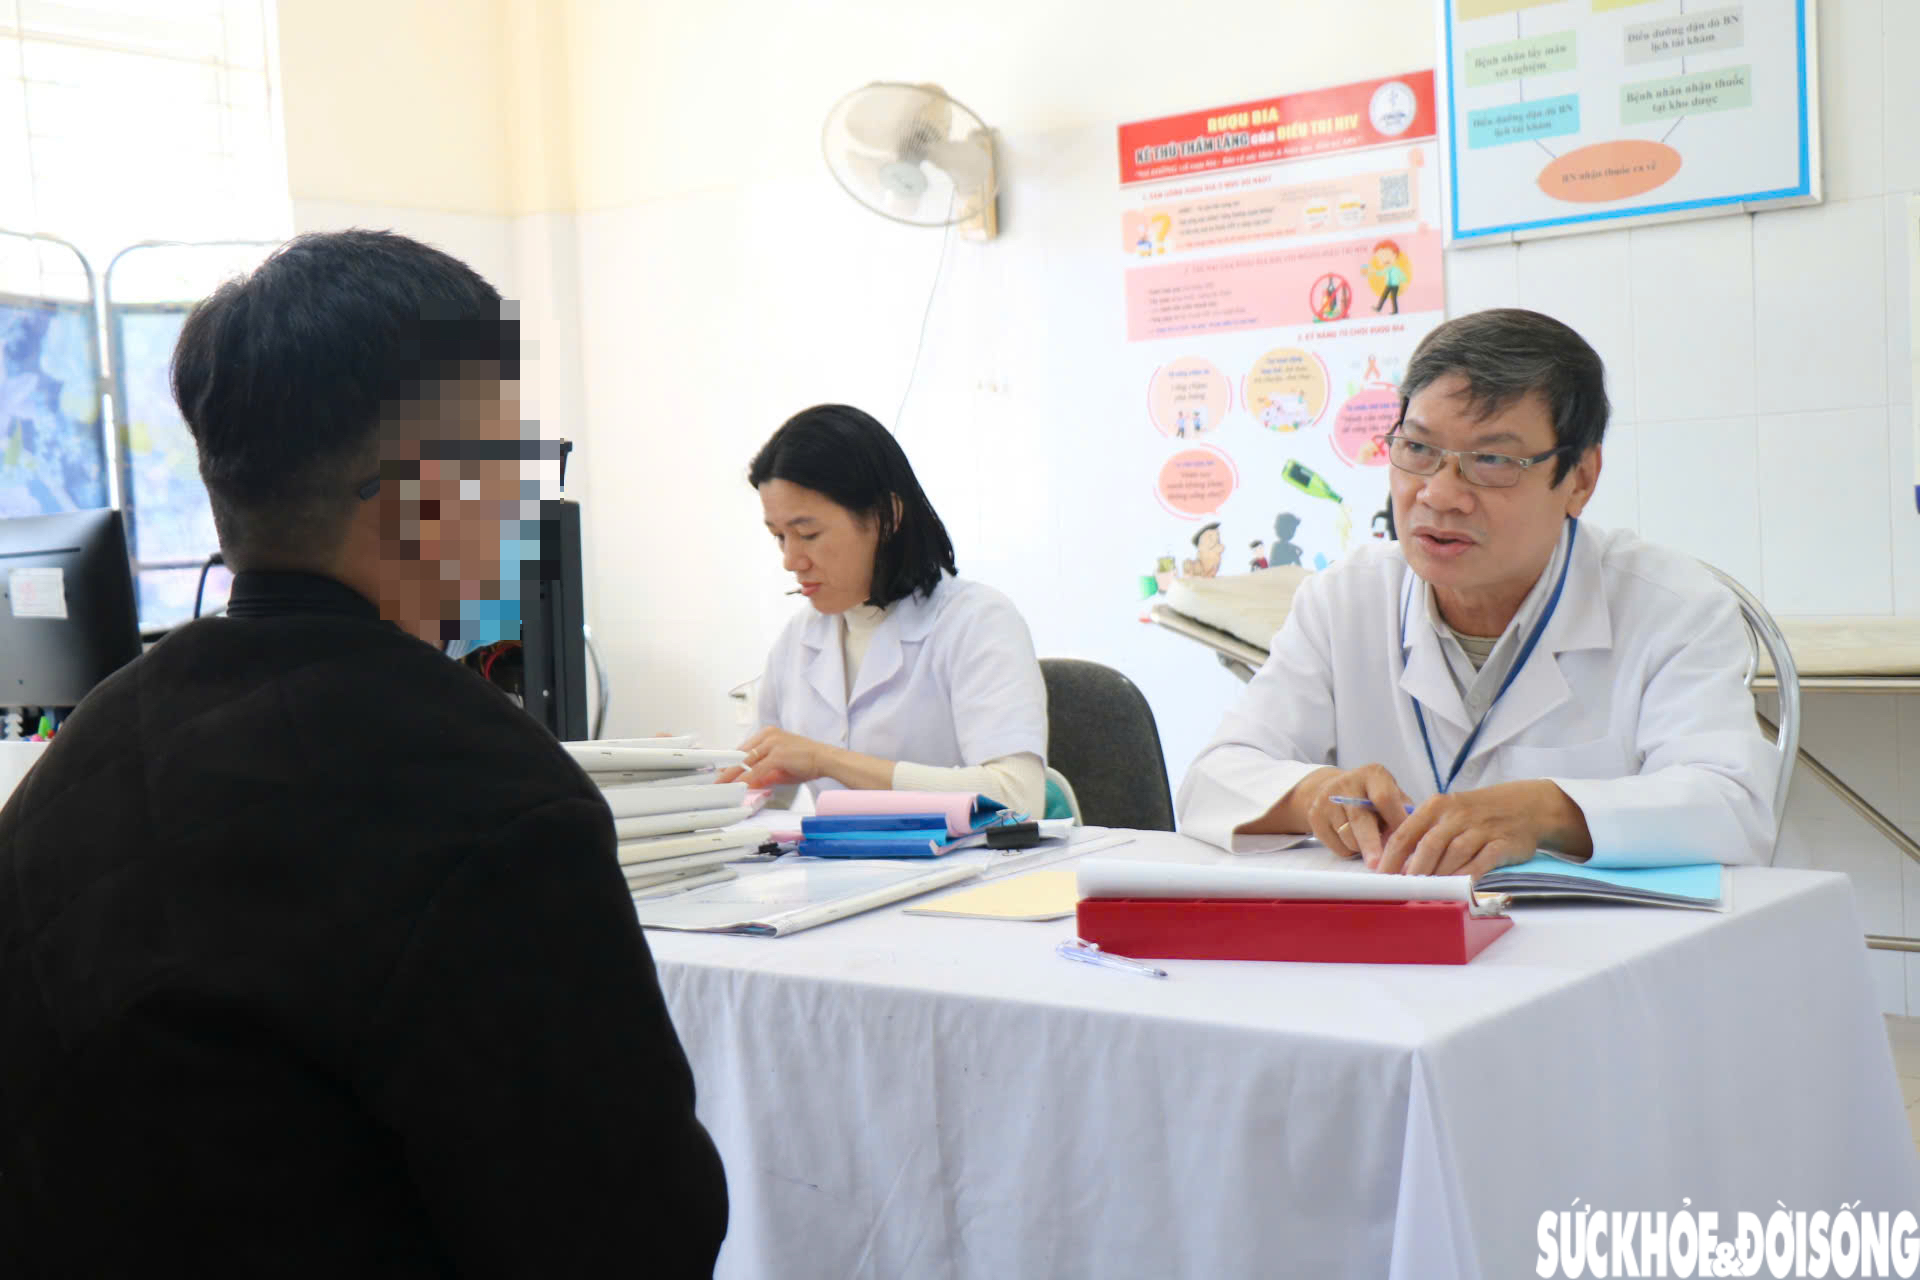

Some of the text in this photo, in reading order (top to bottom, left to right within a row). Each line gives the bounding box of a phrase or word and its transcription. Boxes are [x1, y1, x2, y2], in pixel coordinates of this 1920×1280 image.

[1723, 14, 1740, 25] BN
[1687, 33, 1716, 46] khám
[1626, 89, 1653, 104] Bệnh
[1714, 73, 1745, 89] thuốc
[1669, 98, 1690, 111] kho
[1251, 106, 1279, 126] BIA
